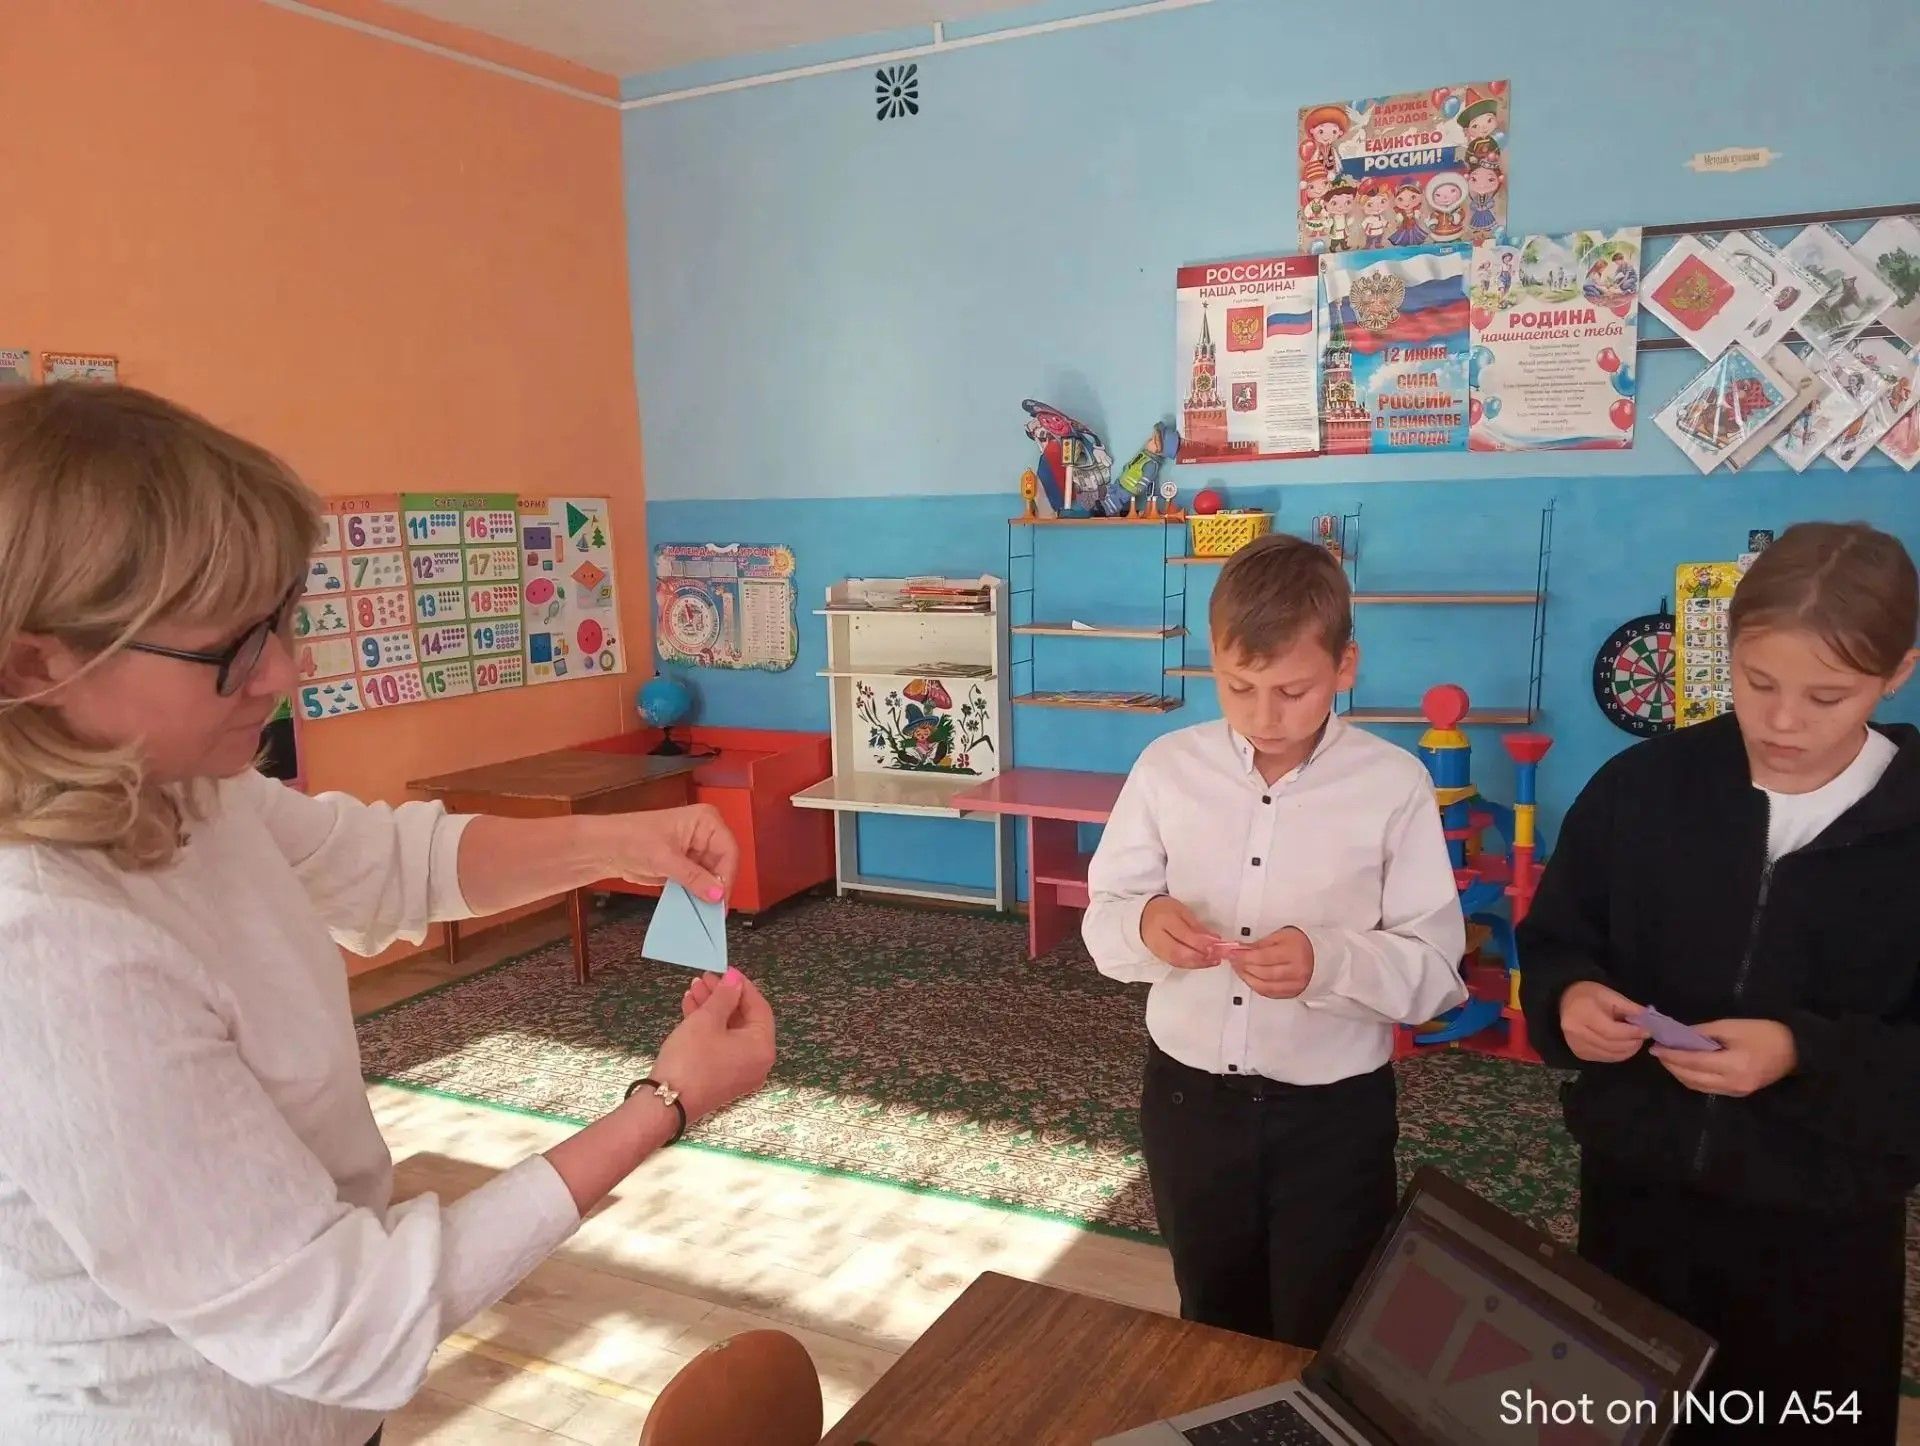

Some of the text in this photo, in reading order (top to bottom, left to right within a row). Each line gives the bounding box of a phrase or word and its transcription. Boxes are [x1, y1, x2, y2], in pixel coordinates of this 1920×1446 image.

[1383, 101, 1428, 114] ДРУЖБЕ
[1365, 131, 1443, 152] ЕДИНСТВО
[1364, 148, 1442, 171] РОССИИ!
[1206, 262, 1295, 284] РОССИЯ-
[1199, 280, 1296, 299] НАША РОДИНА!
[1509, 309, 1596, 328] РОДИНА
[1481, 321, 1624, 343] начинается с тебя
[1383, 346, 1448, 362] 12 ИЮНЯ
[1397, 372, 1438, 388] СИЛА
[1376, 413, 1461, 428] В ЕДИНСТВЕ
[1390, 429, 1451, 446] НАРОДА!
[348, 516, 366, 547] 6
[408, 517, 428, 539] 11
[466, 516, 488, 538] 16
[352, 557, 369, 588] 7
[412, 555, 434, 579] 12
[469, 553, 490, 576] 17
[417, 594, 436, 618] 13
[471, 591, 492, 612] 18
[357, 598, 374, 628] 8
[1626, 630, 1638, 638] 12
[1658, 622, 1671, 630] 20
[421, 632, 443, 655] 14
[473, 627, 494, 649] 19
[1615, 640, 1622, 648] 9
[362, 637, 380, 667] 9
[1602, 656, 1614, 664] 14
[426, 671, 447, 694] 15
[476, 664, 499, 686] 20
[1599, 671, 1611, 679] 11
[365, 675, 400, 705] 10
[1604, 687, 1610, 695] 8
[302, 687, 323, 717] 5
[1632, 721, 1644, 729] 19
